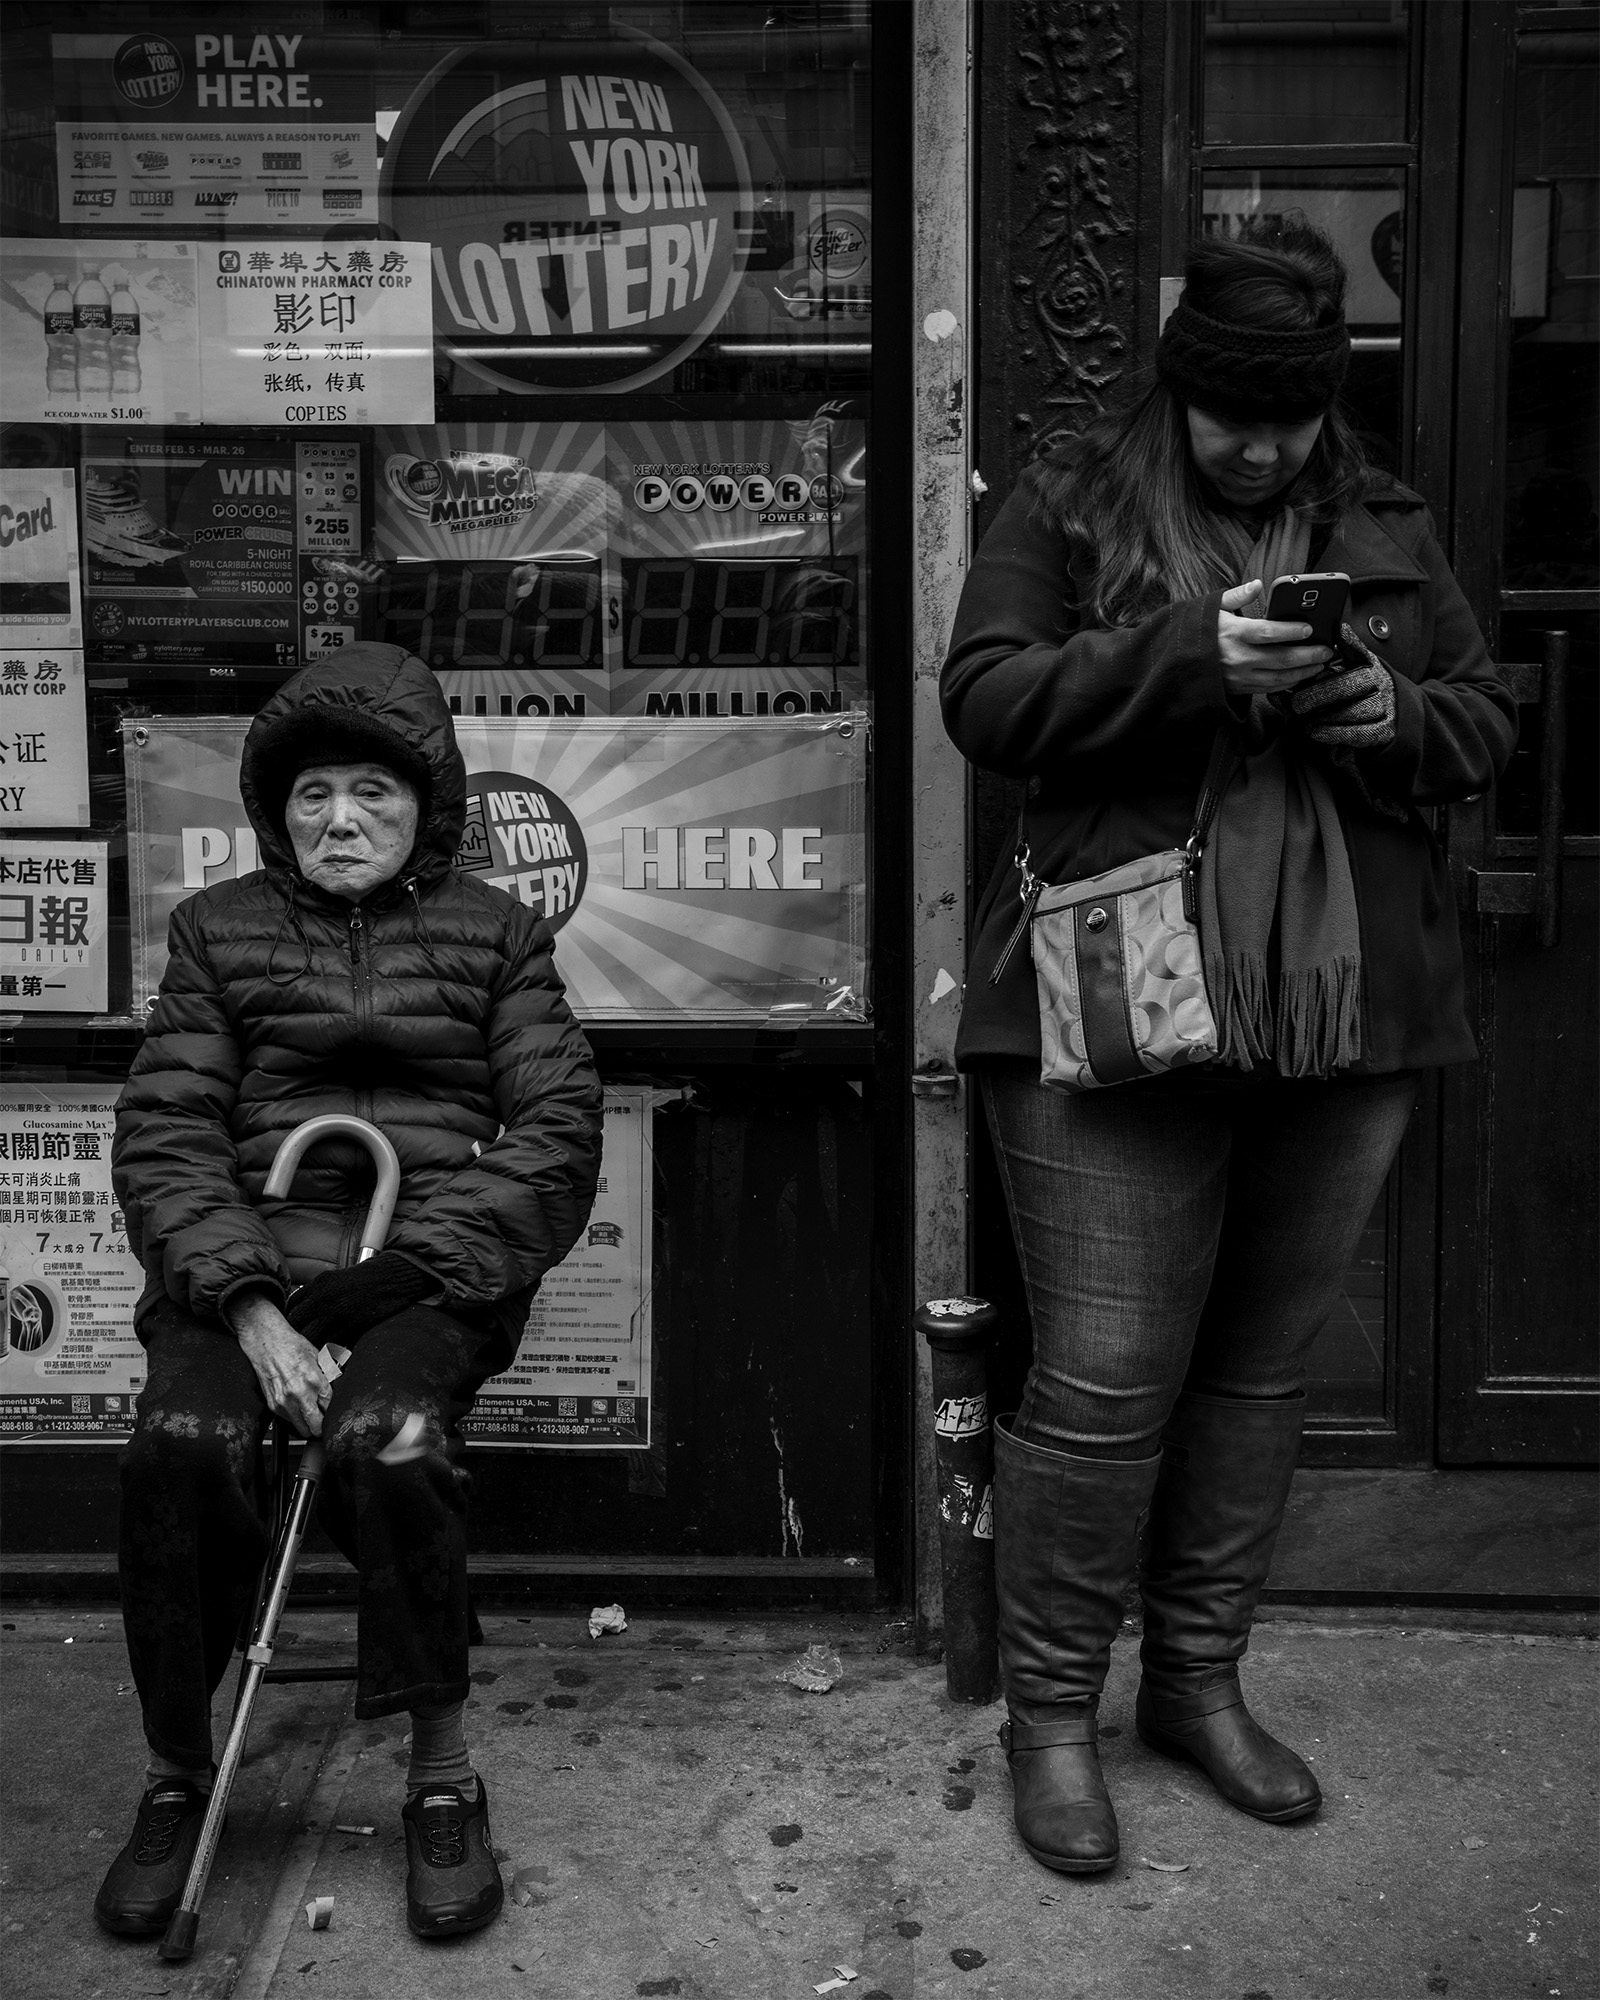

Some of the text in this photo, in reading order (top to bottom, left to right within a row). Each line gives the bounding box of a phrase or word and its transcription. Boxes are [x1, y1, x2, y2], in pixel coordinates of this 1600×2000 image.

[143, 42, 168, 55] NEW
[195, 34, 303, 68] PLAY
[148, 55, 177, 72] YORK
[121, 70, 180, 98] LOTTERY
[197, 74, 323, 108] HERE.
[561, 75, 673, 133] NEW
[71, 132, 360, 142] FAVORITE GAMES. NEW GAMES. ALWAYS A REASON TO PLAY!
[73, 153, 112, 161] CASH
[191, 156, 232, 166] POWER
[74, 162, 112, 170] 4LIFE
[569, 137, 707, 216] YORK
[74, 191, 114, 204] TAKE 5
[130, 191, 173, 205] NUMBERS
[267, 193, 288, 207] PICK
[813, 241, 862, 258] Seltzer
[247, 251, 409, 273] 華埠大藥房
[216, 276, 413, 288] CHINATOWN PHARMACY CORP
[431, 218, 718, 336] LOTTERY
[79, 311, 106, 322] Spring
[273, 292, 356, 333] 影印
[110, 407, 143, 420] $1.00
[285, 405, 347, 422] COPIES
[129, 445, 246, 455] ENTER FEB. 5 MAR. 26
[302, 448, 347, 457] POWER
[306, 471, 356, 480] 6 13 16
[634, 463, 771, 475] NEW YORK LOTTERY'S
[217, 469, 292, 495] WIN
[435, 460, 537, 500] MEGA
[304, 487, 356, 497] 17 52 25
[643, 480, 802, 506] POWER
[212, 504, 278, 518] POWER
[430, 497, 536, 525] MILLIONS
[305, 515, 350, 535] $ 255
[450, 516, 519, 533] MEGAPLIER
[194, 526, 293, 545] POWER CRUISE
[307, 537, 351, 547] MILLION
[247, 549, 293, 560] 5-NIGHT
[189, 560, 292, 570] ROYAL CARIBBEAN CRUISE
[240, 580, 293, 595] $150,000
[307, 585, 358, 595] 3 6 29
[94, 603, 122, 620] PLAYERS
[304, 602, 355, 611] 30 64 3
[5, 615, 66, 625] side facing you
[127, 616, 290, 628] NYLOTTERYPLAYERSCLUB.COM
[101, 625, 120, 635] CLUB
[310, 628, 344, 648] $ 25
[209, 668, 236, 677] DELL
[33, 683, 66, 696] CORP
[645, 691, 843, 718] MILLION
[487, 791, 551, 822] NEW
[494, 822, 573, 867] YORK
[622, 827, 822, 890] HERE
[21, 948, 83, 963] DAILY
[23, 1120, 84, 1129] Glucosamine
[93, 1360, 112, 1369] MSM
[479, 1399, 552, 1408] Elements USA, Inc.
[51, 1421, 104, 1431] 1-212-308-9067
[607, 1416, 637, 1425] UMEUSA
[466, 1422, 590, 1435] 1-877-808-6188 1-212-308-9067
